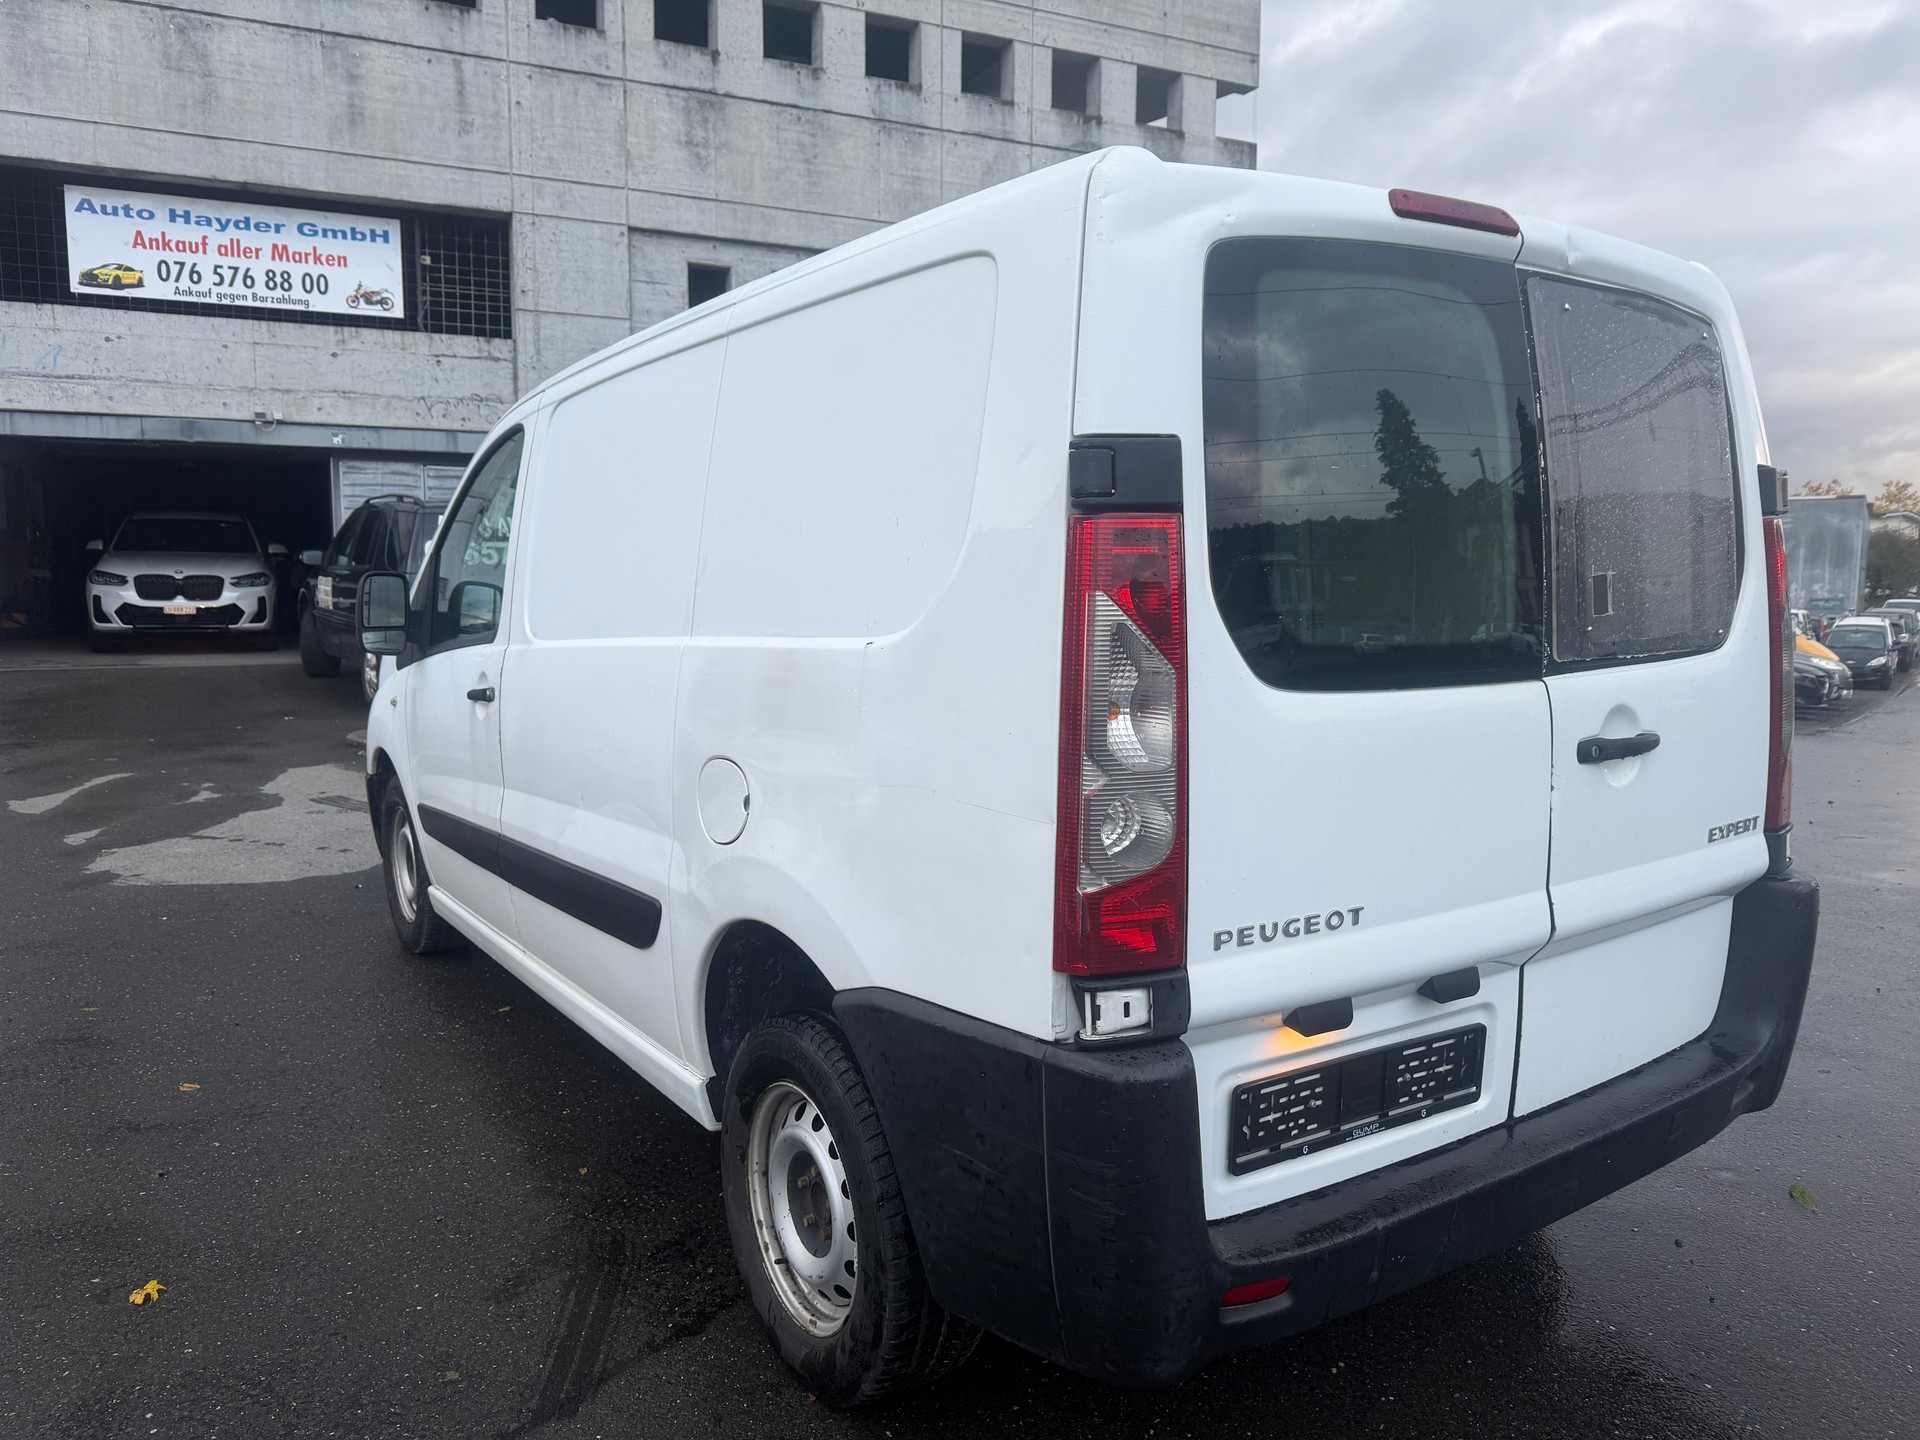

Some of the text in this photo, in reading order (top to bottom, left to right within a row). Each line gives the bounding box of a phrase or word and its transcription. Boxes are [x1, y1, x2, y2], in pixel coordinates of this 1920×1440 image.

[74, 197, 390, 244] Auto Hayder GmbH
[132, 230, 348, 268] Ankauf aller Marken
[157, 259, 329, 295] 076 576 88 00
[173, 285, 310, 309] Ankauf gegen Barzahlung
[1707, 815, 1760, 844] EXPERT
[1213, 906, 1365, 951] PEUGEOT
[1352, 1123, 1379, 1136] GUMP
